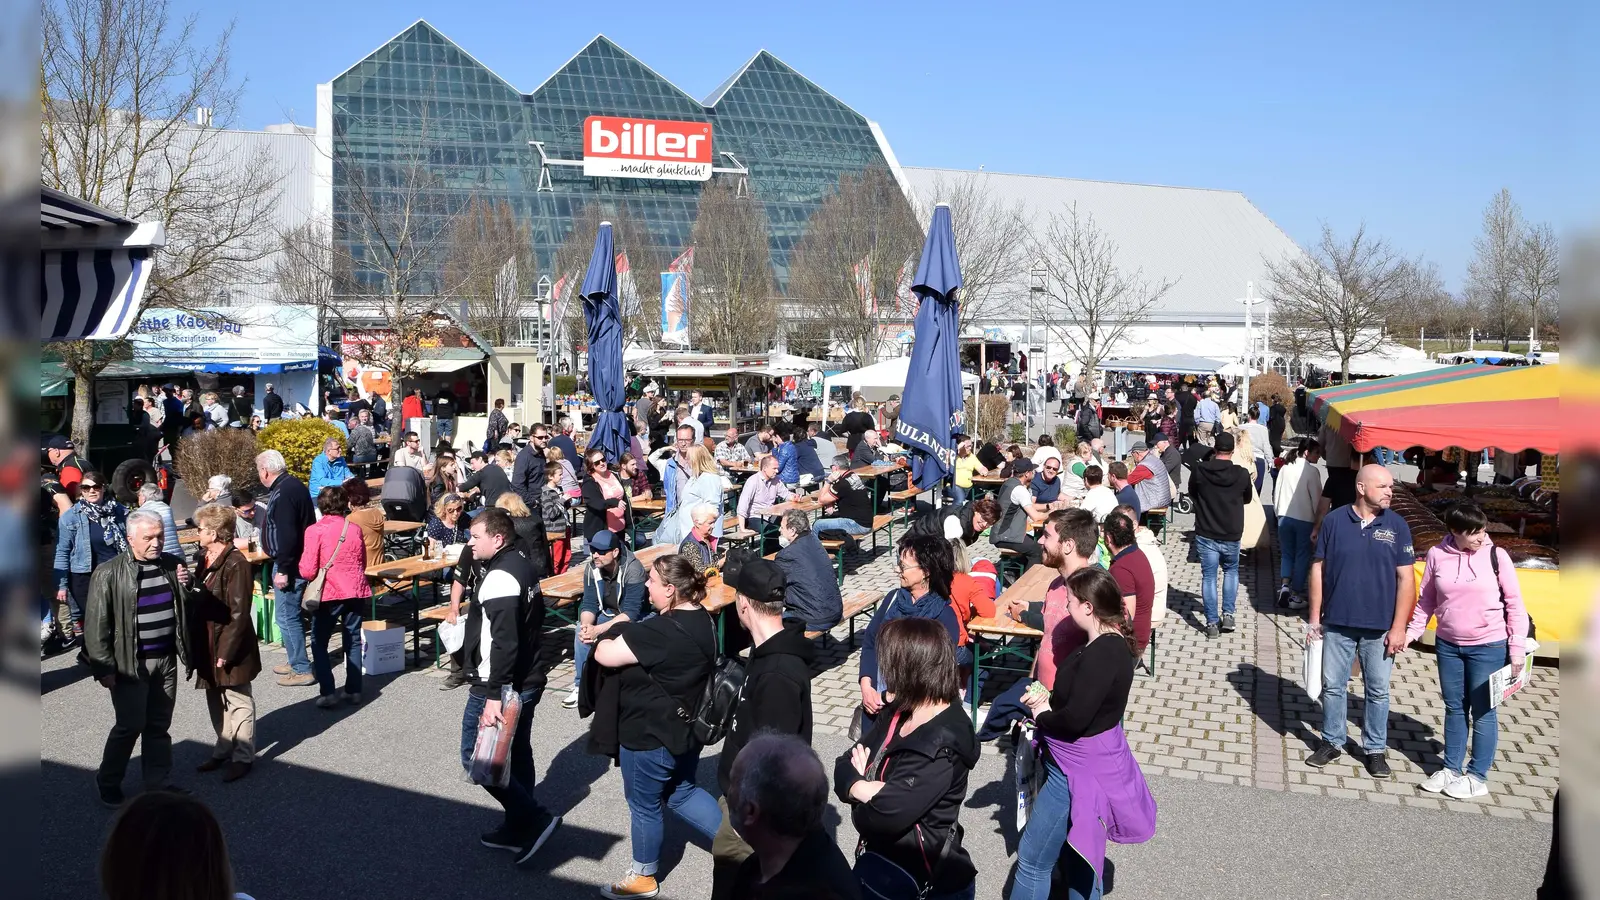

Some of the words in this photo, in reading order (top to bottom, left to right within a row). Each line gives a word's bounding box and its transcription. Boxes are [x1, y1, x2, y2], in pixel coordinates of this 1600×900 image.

[592, 121, 705, 158] biller
[657, 163, 706, 178] glücklich!
[133, 315, 170, 334] äthe
[152, 335, 169, 343] Fisch
[171, 335, 217, 346] Spezialitäten
[896, 415, 957, 467] AULANER
